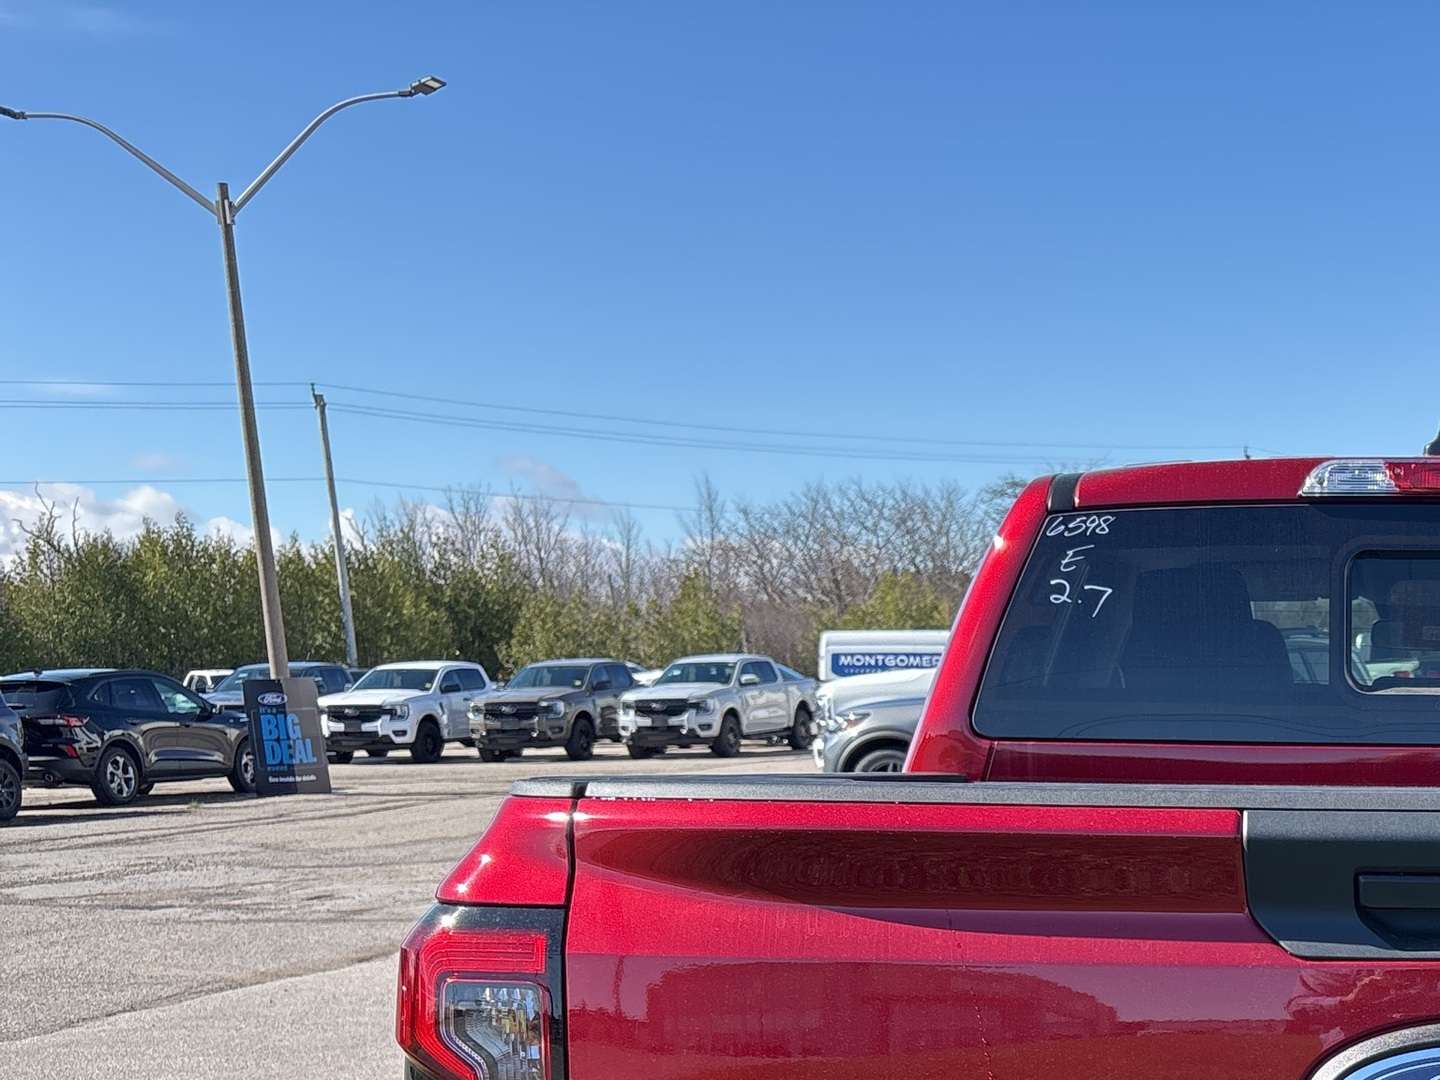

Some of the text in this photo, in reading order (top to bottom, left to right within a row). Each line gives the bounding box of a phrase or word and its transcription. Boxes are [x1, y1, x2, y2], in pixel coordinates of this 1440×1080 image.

[1046, 515, 1116, 537] 6598
[1060, 544, 1095, 572] E
[260, 713, 302, 740] BIG
[264, 738, 317, 764] DEAL
